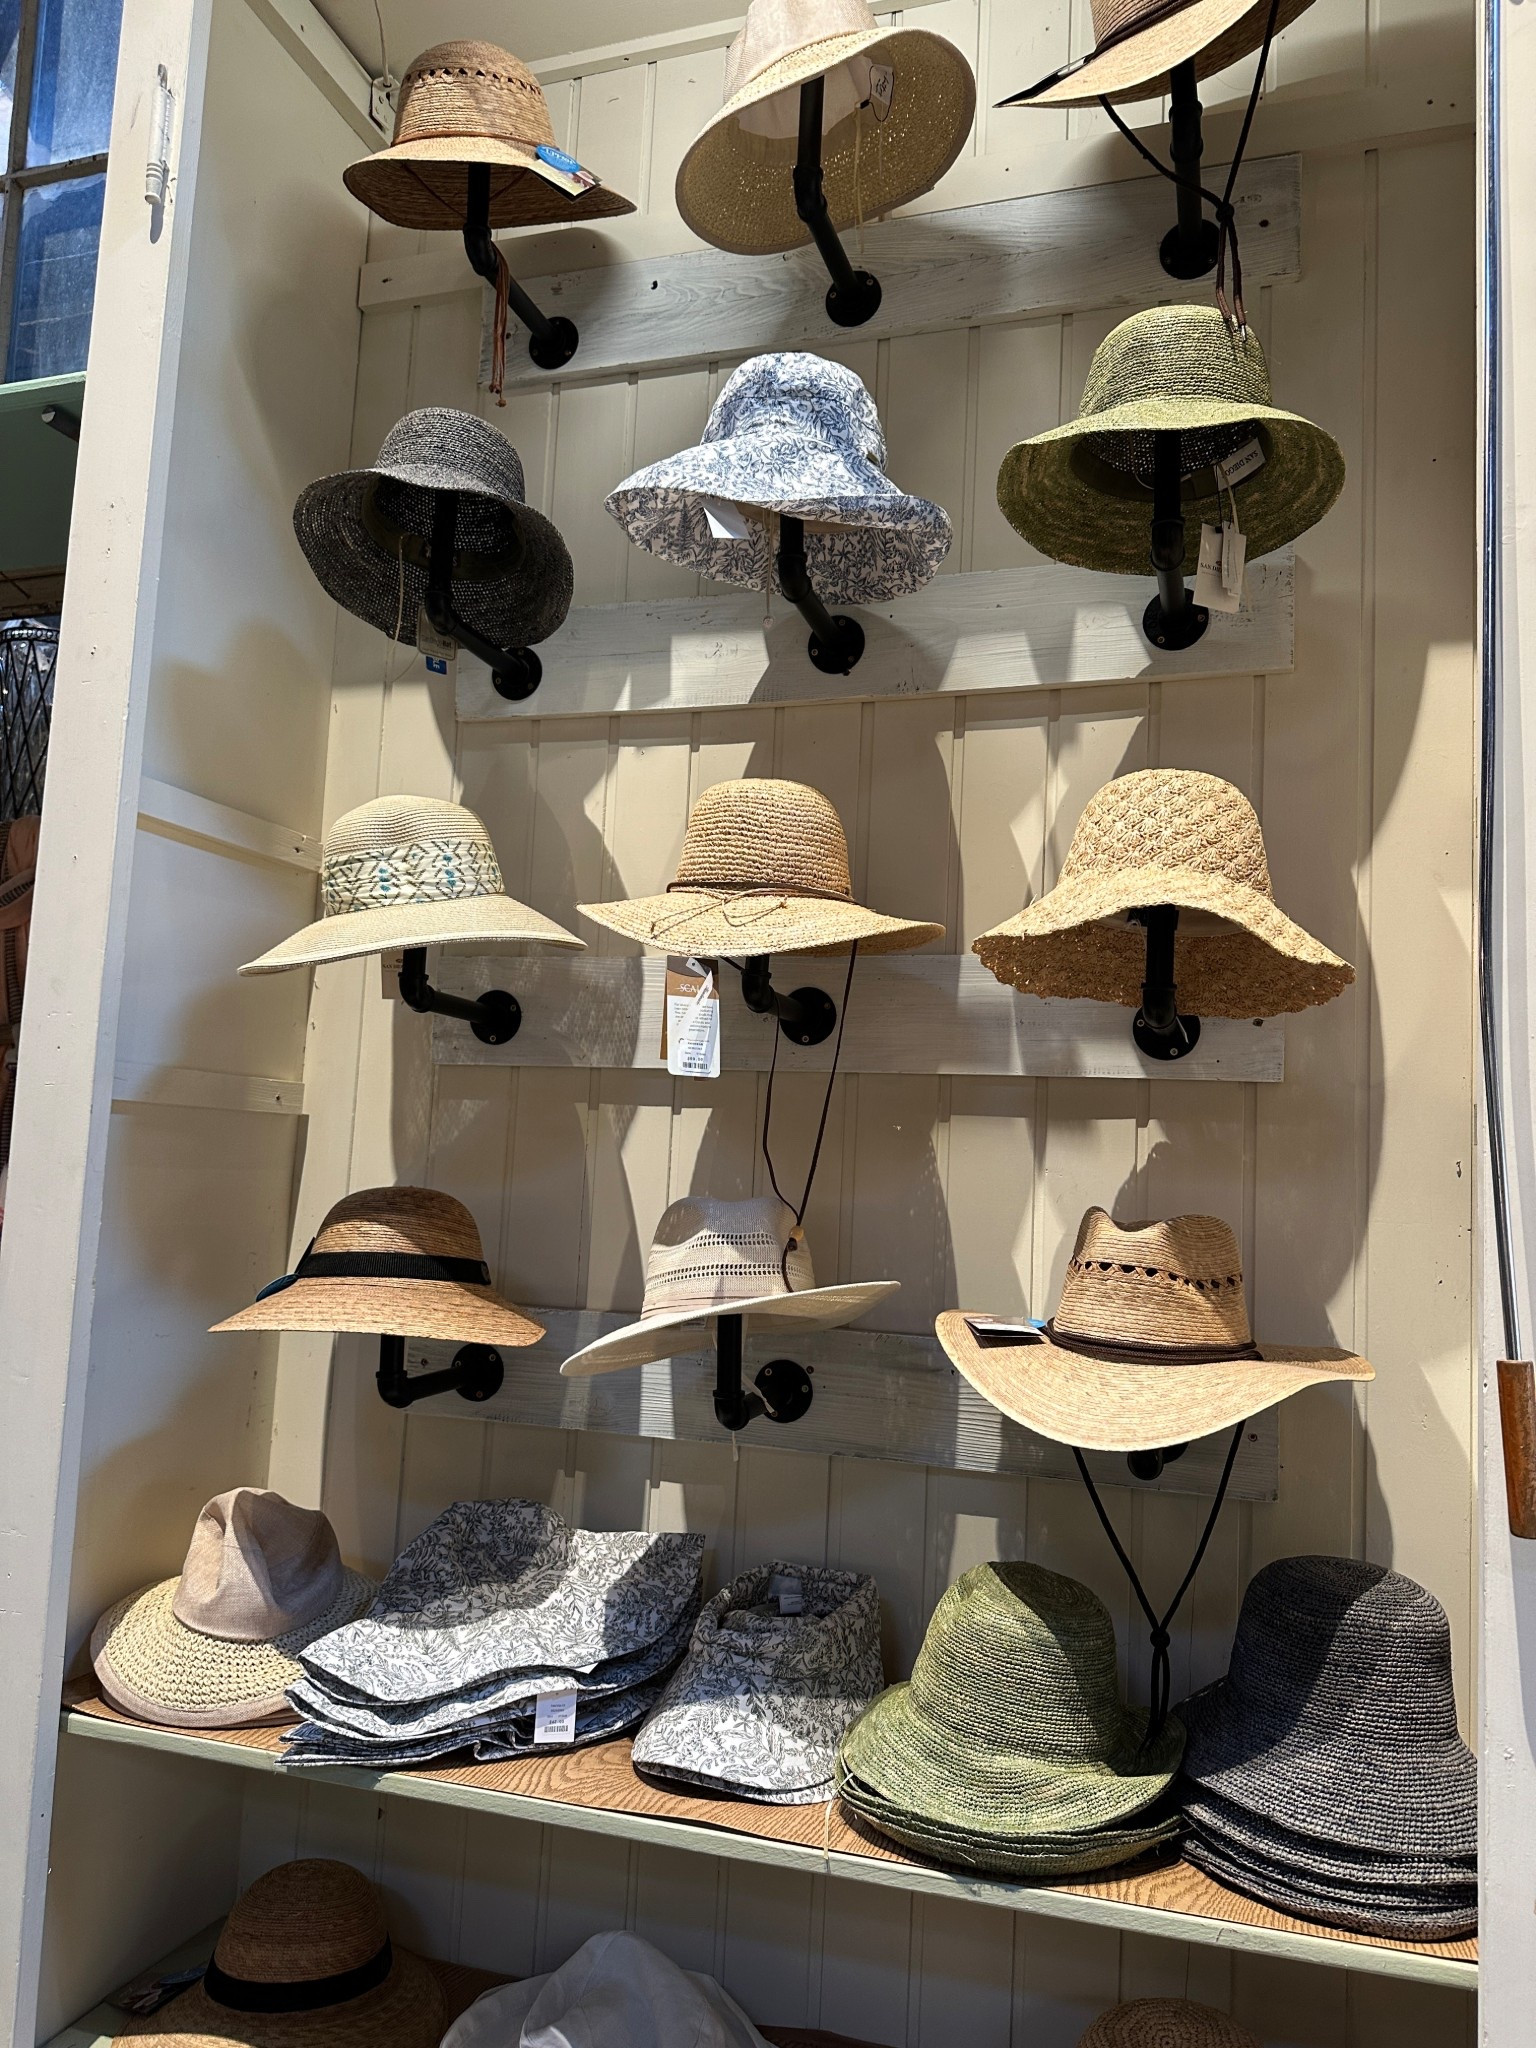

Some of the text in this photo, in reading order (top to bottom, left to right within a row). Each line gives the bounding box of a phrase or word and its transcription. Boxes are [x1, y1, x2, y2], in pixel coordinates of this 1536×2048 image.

[1224, 450, 1259, 477] SAN DIEGO
[1200, 562, 1212, 571] SAN
